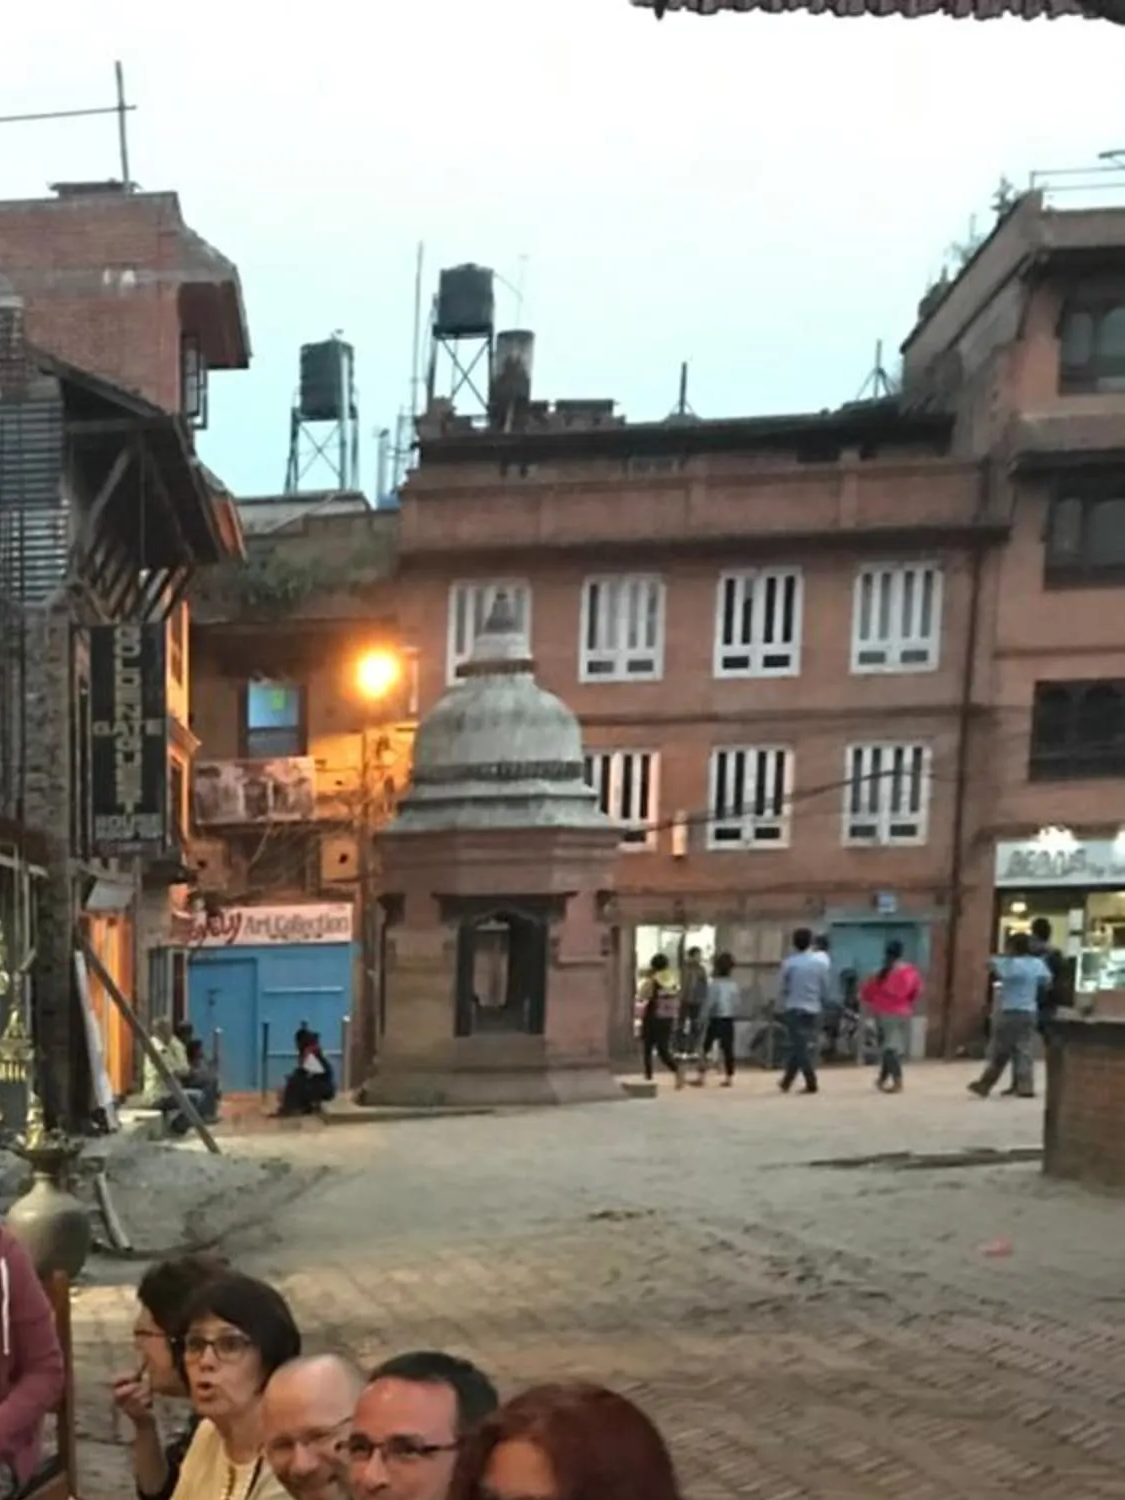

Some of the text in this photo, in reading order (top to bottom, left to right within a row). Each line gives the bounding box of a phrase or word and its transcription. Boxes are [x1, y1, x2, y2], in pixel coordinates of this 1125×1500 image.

[113, 624, 142, 721] GOLDEN
[92, 719, 163, 736] GATE
[245, 916, 271, 937] Art
[274, 913, 349, 937] Collection
